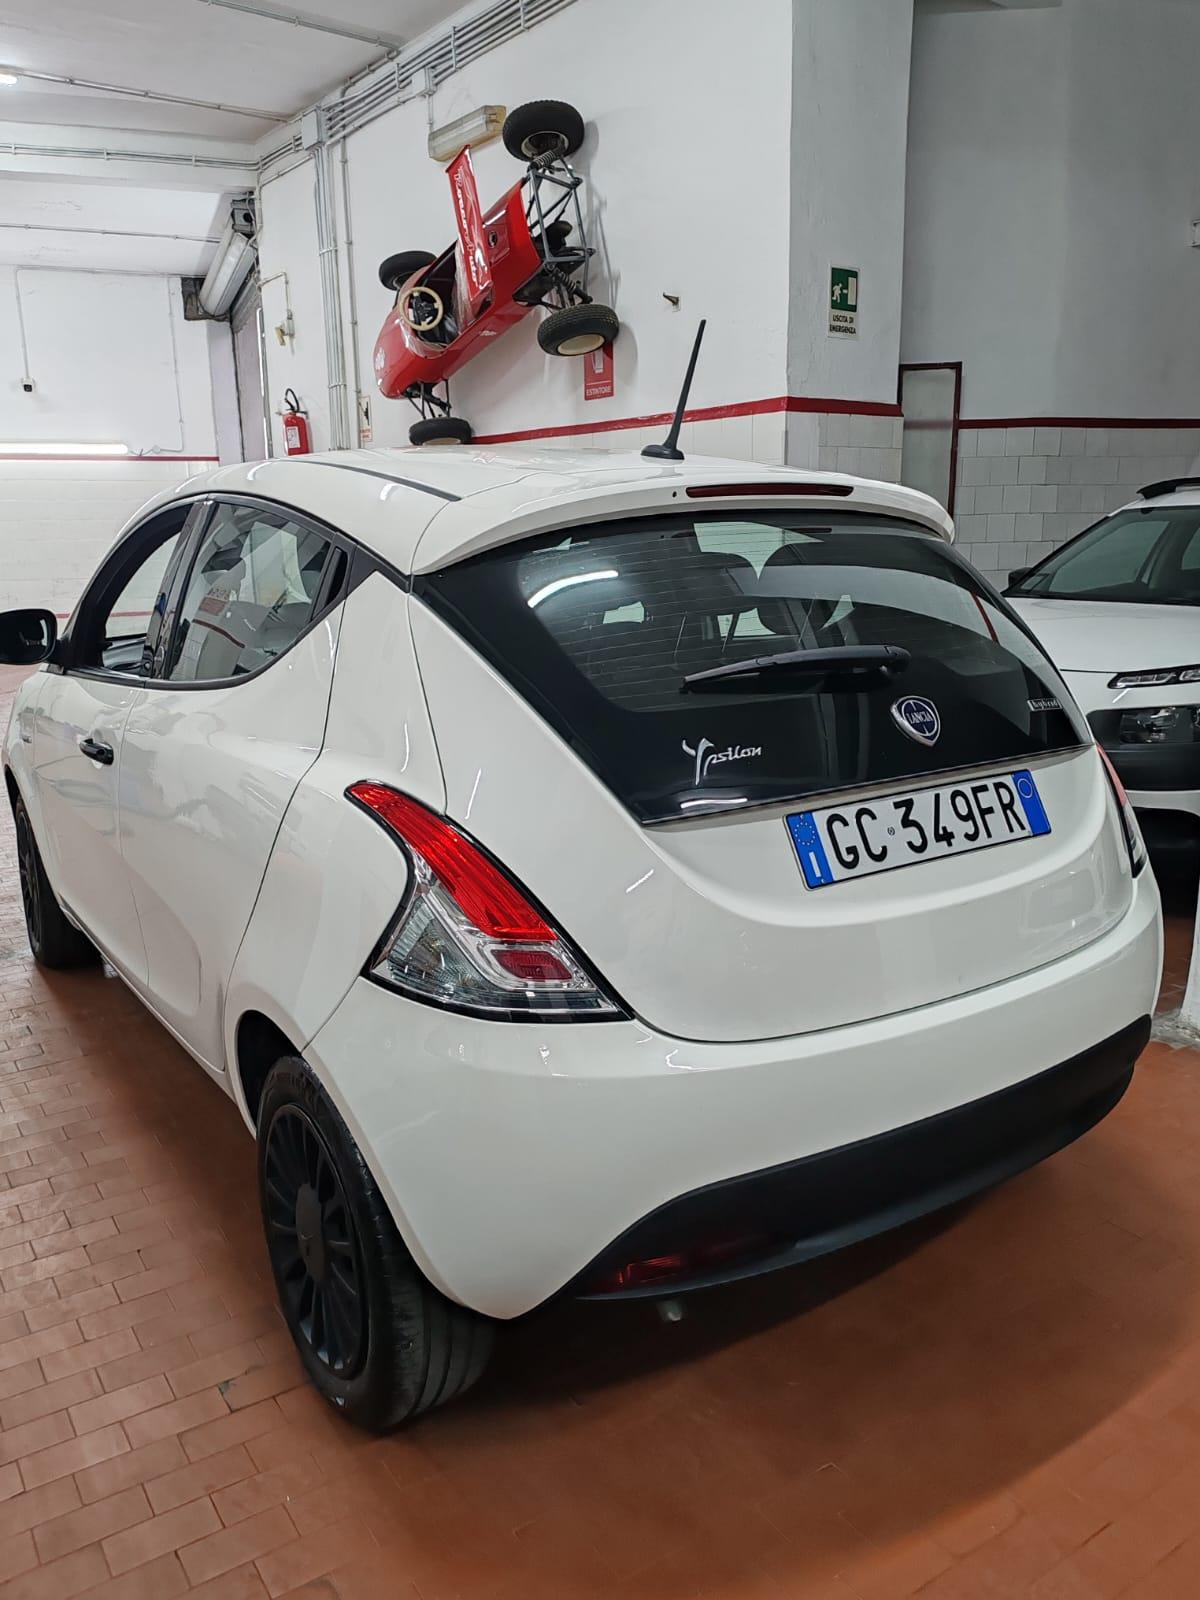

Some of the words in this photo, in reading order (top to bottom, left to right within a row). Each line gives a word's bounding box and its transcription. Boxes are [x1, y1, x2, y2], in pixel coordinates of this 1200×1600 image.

[832, 314, 848, 323] USCITA
[848, 316, 854, 324] DI
[829, 324, 857, 335] EMERGENZA
[586, 386, 612, 397] ESTINTORE
[1030, 699, 1059, 710] hybrid
[905, 711, 934, 724] LANCIA
[682, 737, 762, 786] Ypsilon
